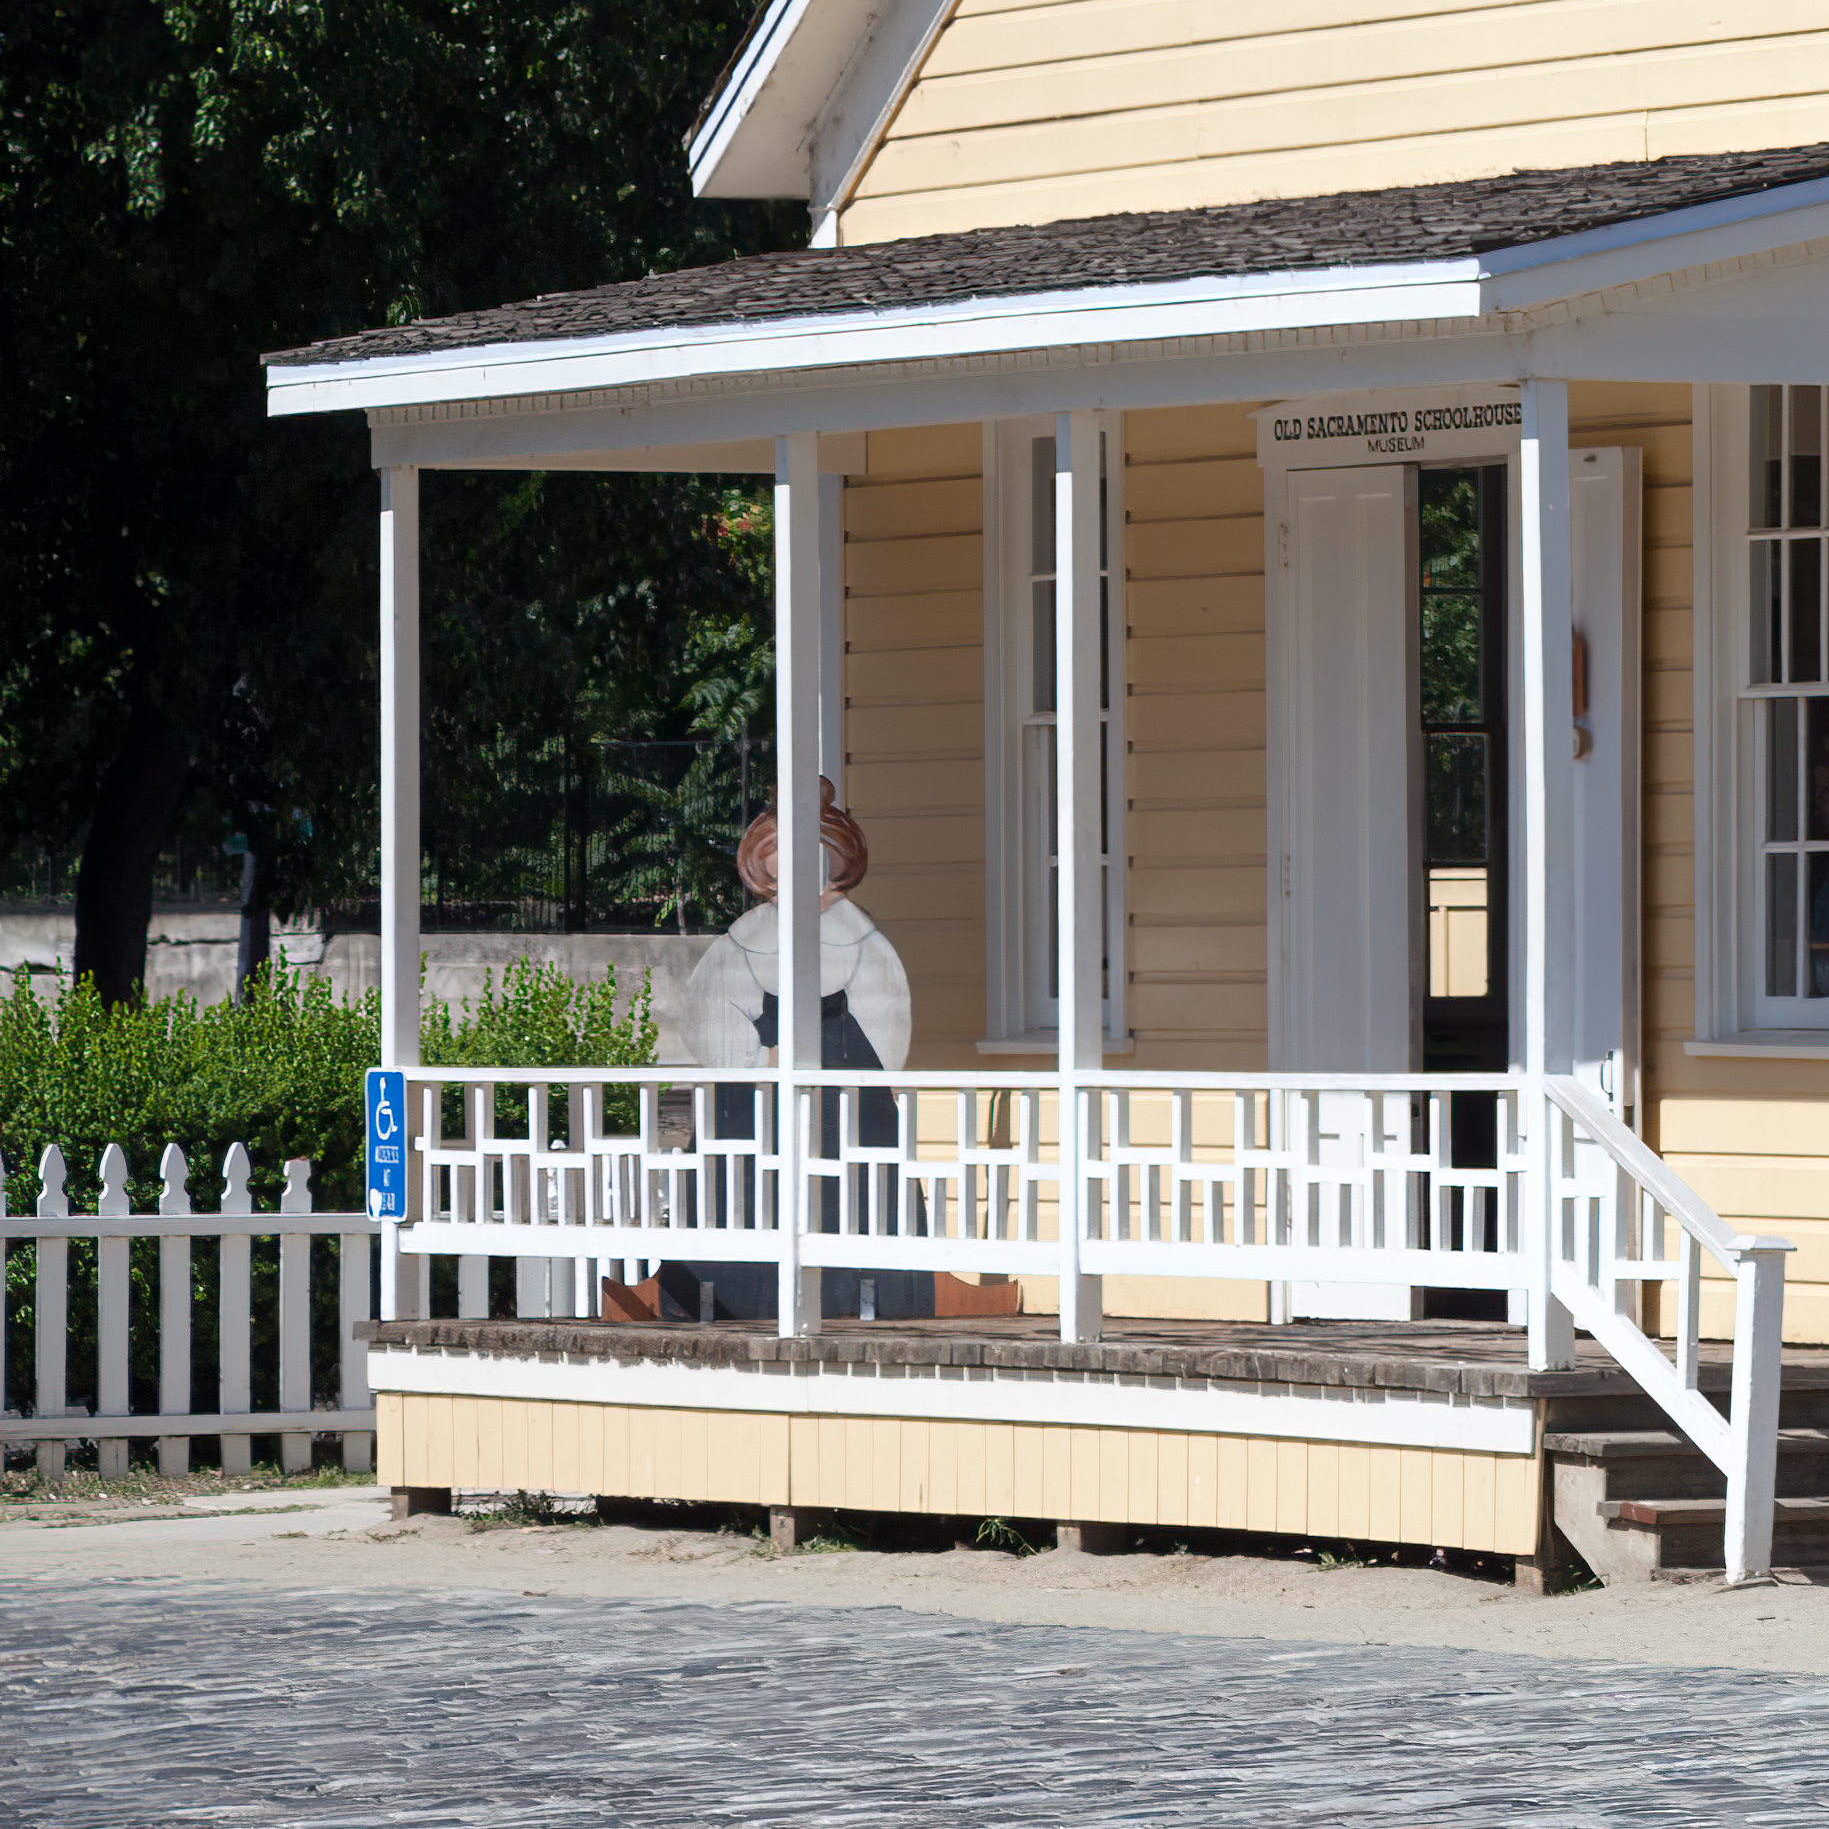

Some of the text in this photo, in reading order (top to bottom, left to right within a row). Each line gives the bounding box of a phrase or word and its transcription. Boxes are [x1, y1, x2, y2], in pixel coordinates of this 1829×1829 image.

[1274, 402, 1522, 441] OLD SACRAMENTO SCHOOLHOUSE
[1367, 436, 1425, 453] MUSEUM
